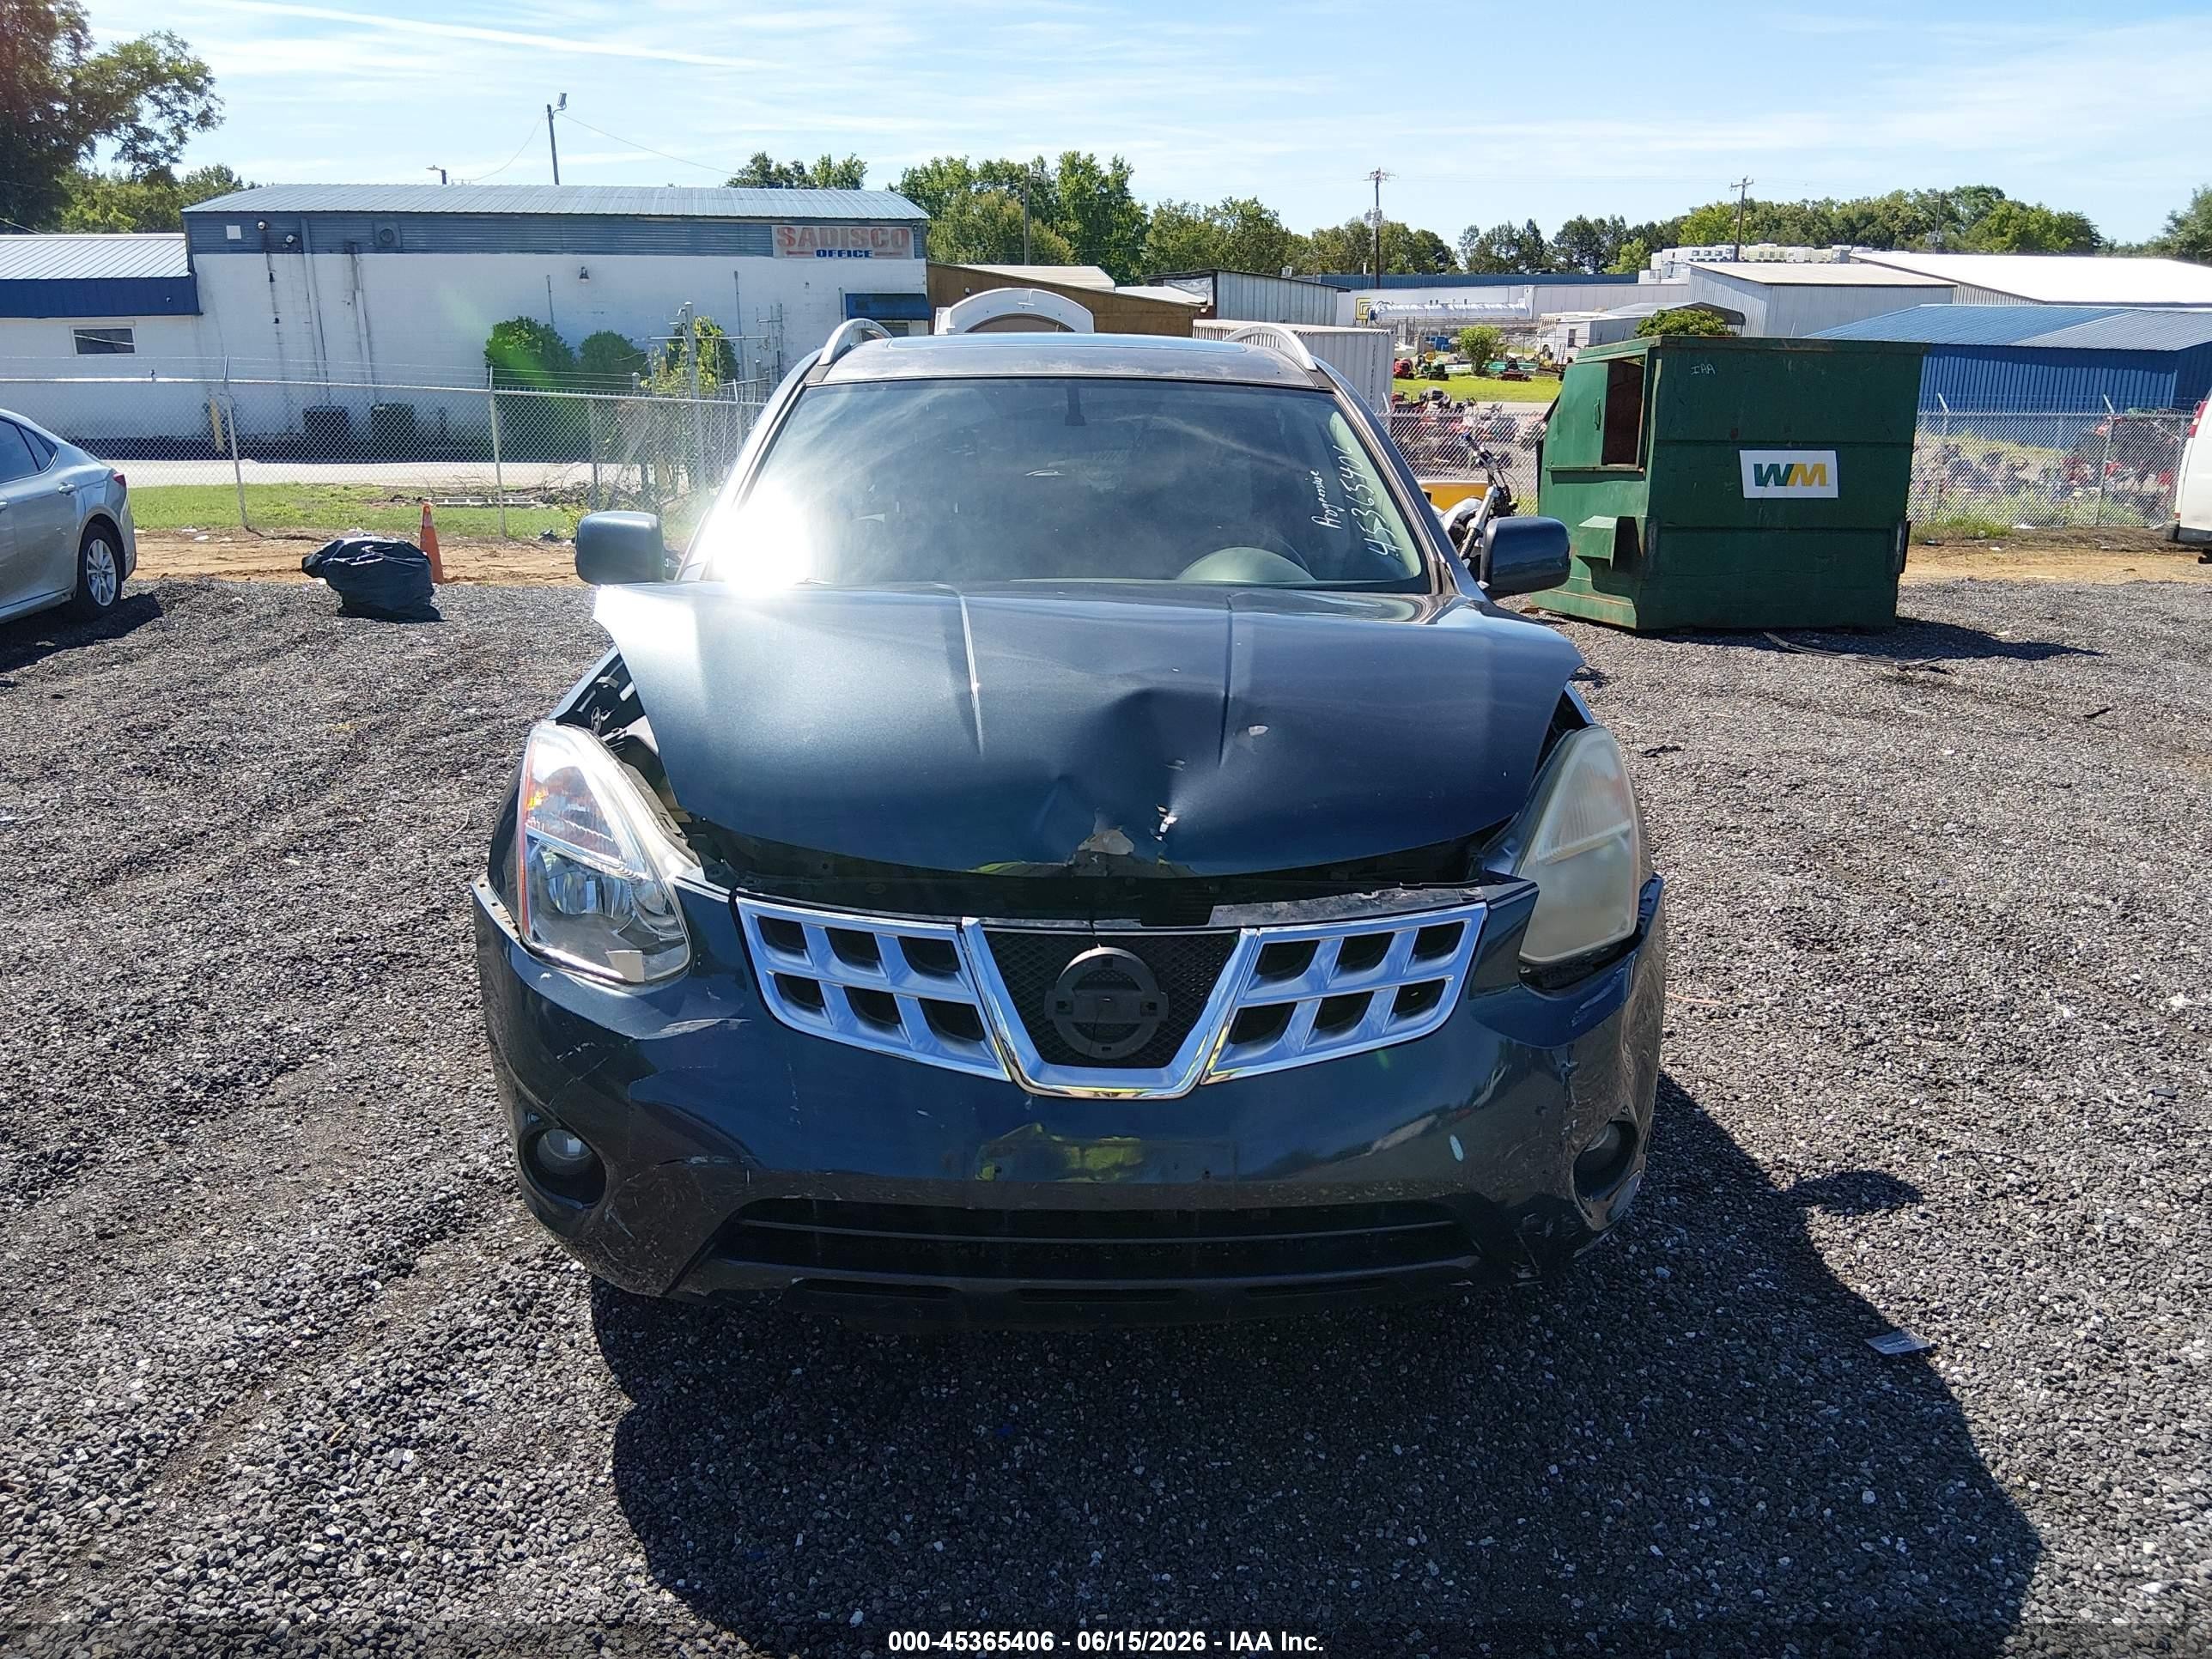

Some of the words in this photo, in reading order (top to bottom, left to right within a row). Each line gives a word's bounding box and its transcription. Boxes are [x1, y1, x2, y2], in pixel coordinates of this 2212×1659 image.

[777, 226, 909, 248] SADISCO
[816, 249, 873, 258] OFFICE
[1690, 363, 1716, 375] IAA
[1753, 463, 1827, 487] WM
